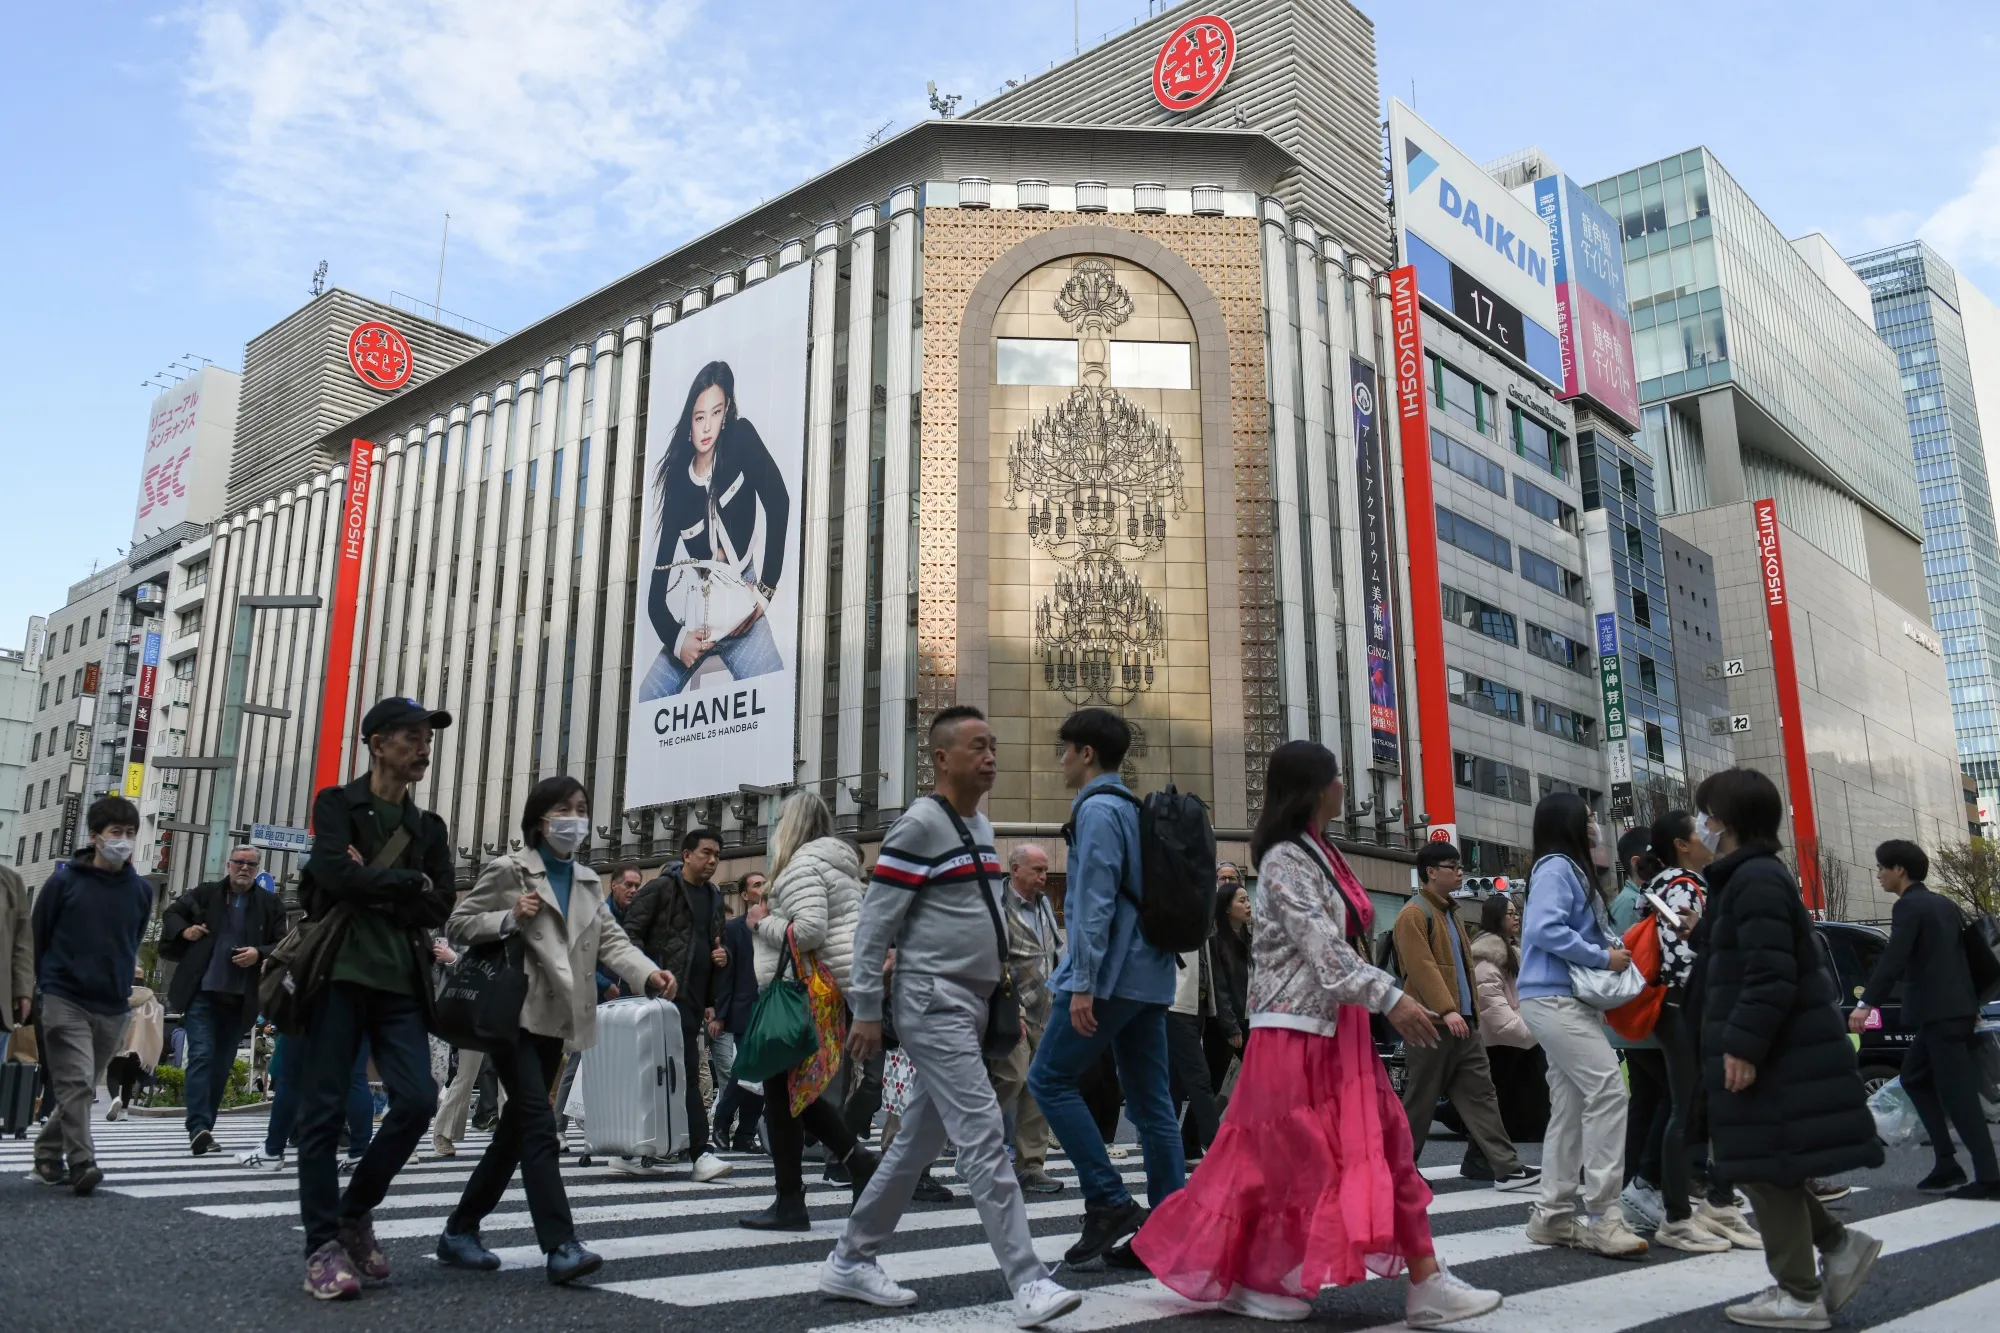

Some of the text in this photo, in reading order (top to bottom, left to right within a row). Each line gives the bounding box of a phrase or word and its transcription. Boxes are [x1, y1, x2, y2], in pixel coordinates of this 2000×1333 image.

[1438, 177, 1546, 287] DAIKIN
[1582, 212, 1612, 260] 龍角散
[1470, 289, 1493, 331] 17
[1395, 277, 1419, 418] MITSUKOSHI
[148, 412, 196, 452] メンテナンス
[151, 391, 199, 432] リニューアル
[139, 446, 191, 519] SEC
[346, 447, 370, 560] MITSUKOSHI
[1362, 423, 1384, 641] アートアクアリウム美術館
[1759, 506, 1783, 606] MITSUKOSHI
[1367, 644, 1391, 660] GINZA
[1727, 662, 1742, 674] わ
[654, 689, 765, 735] CHANEL
[1605, 673, 1621, 722] 伸芽会
[659, 721, 758, 748] THE CHANEL 25 HANDBAG
[1733, 717, 1748, 730] ね
[254, 830, 304, 844] 銀座四丁目
